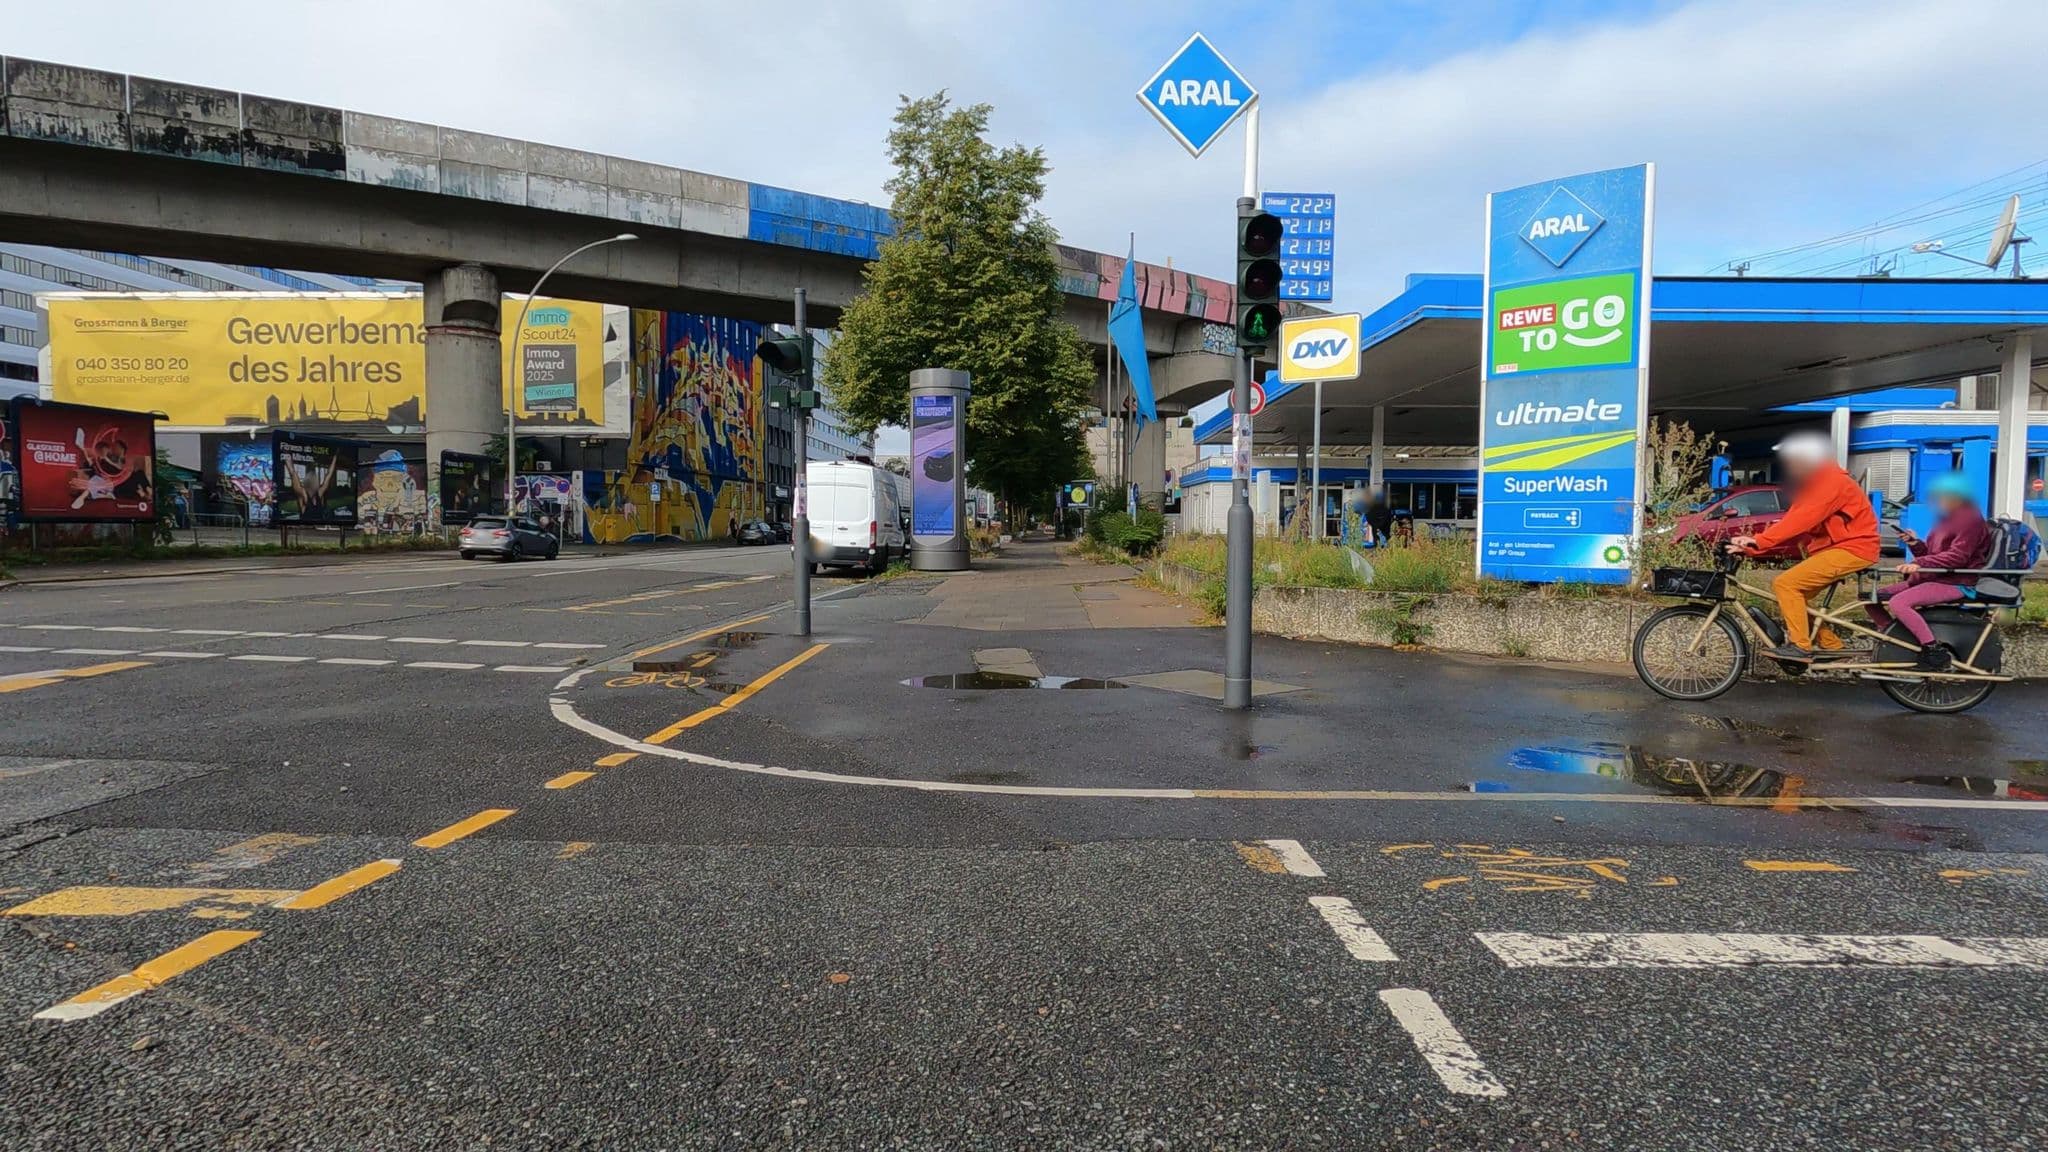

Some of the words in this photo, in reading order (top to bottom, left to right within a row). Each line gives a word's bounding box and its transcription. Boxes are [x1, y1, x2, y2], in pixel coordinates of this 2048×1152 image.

[1158, 79, 1241, 106] ARAL
[1529, 213, 1590, 241] ARAL
[530, 312, 567, 323] Immo
[1502, 305, 1554, 328] REWE
[1562, 294, 1626, 330] GO
[74, 317, 138, 328] Grossmann
[140, 318, 149, 328] &
[150, 317, 188, 329] Berger
[522, 328, 577, 341] Scout24
[1518, 328, 1558, 353] TO
[525, 347, 561, 359] Immo
[1292, 337, 1349, 360] DKV
[75, 357, 107, 371] 040
[110, 357, 141, 371] 350
[144, 357, 165, 371] 80
[167, 357, 189, 371] 20
[228, 354, 290, 383] des
[296, 354, 403, 383] Jahres
[525, 359, 565, 371] Award
[75, 374, 190, 386] grossmann-berger.de
[525, 370, 555, 382] 2025
[1495, 398, 1623, 426] ultimate
[34, 451, 77, 463] @HOME
[1503, 474, 1609, 497] SuperWash
